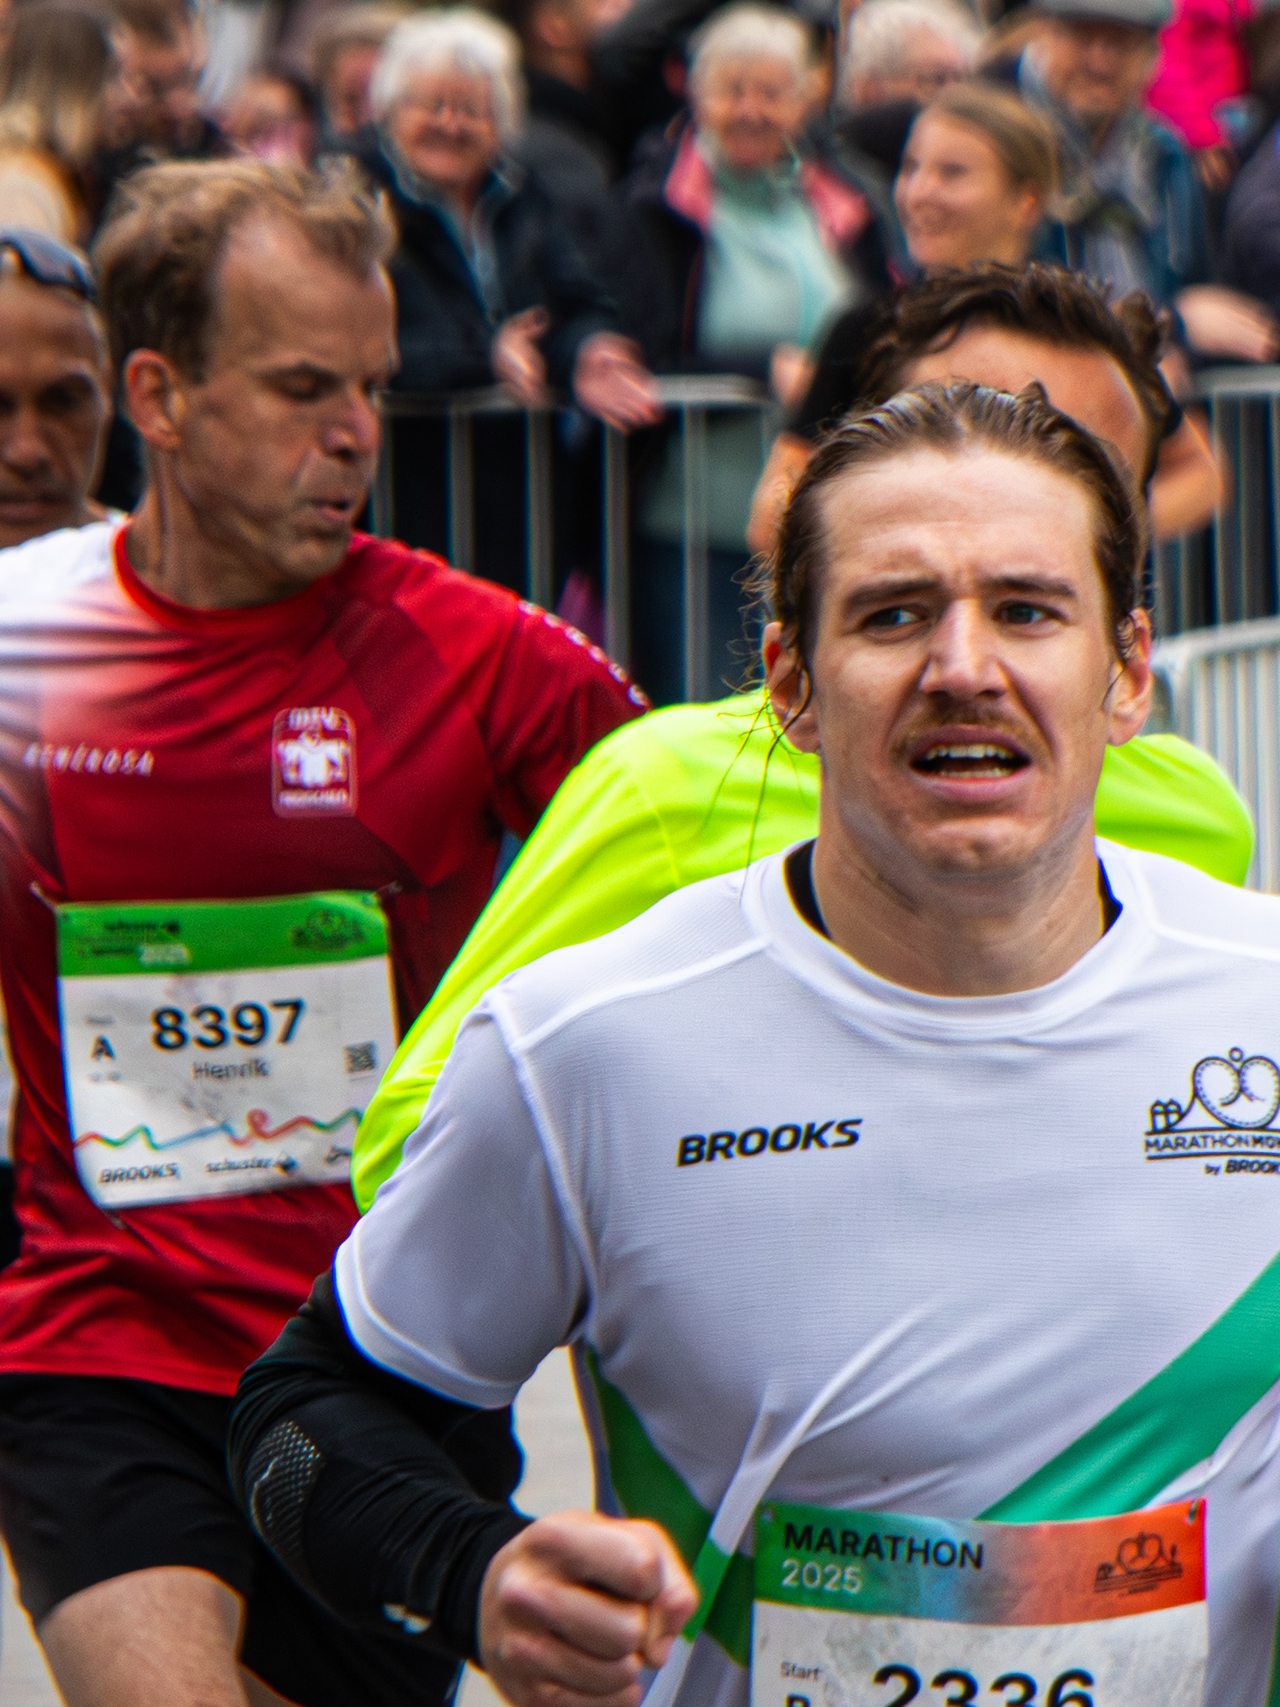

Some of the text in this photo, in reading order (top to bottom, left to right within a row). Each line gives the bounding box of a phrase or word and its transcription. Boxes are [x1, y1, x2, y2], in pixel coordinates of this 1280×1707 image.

[150, 997, 305, 1053] 8397
[90, 1034, 117, 1062] A
[192, 1056, 269, 1080] Henrik
[675, 1118, 864, 1169] BROOKS
[98, 1162, 178, 1185] BROOKS
[1204, 1163, 1221, 1177] by
[784, 1522, 984, 1571] MARATHON
[781, 1557, 863, 1594] 2025
[780, 1660, 820, 1682] Start
